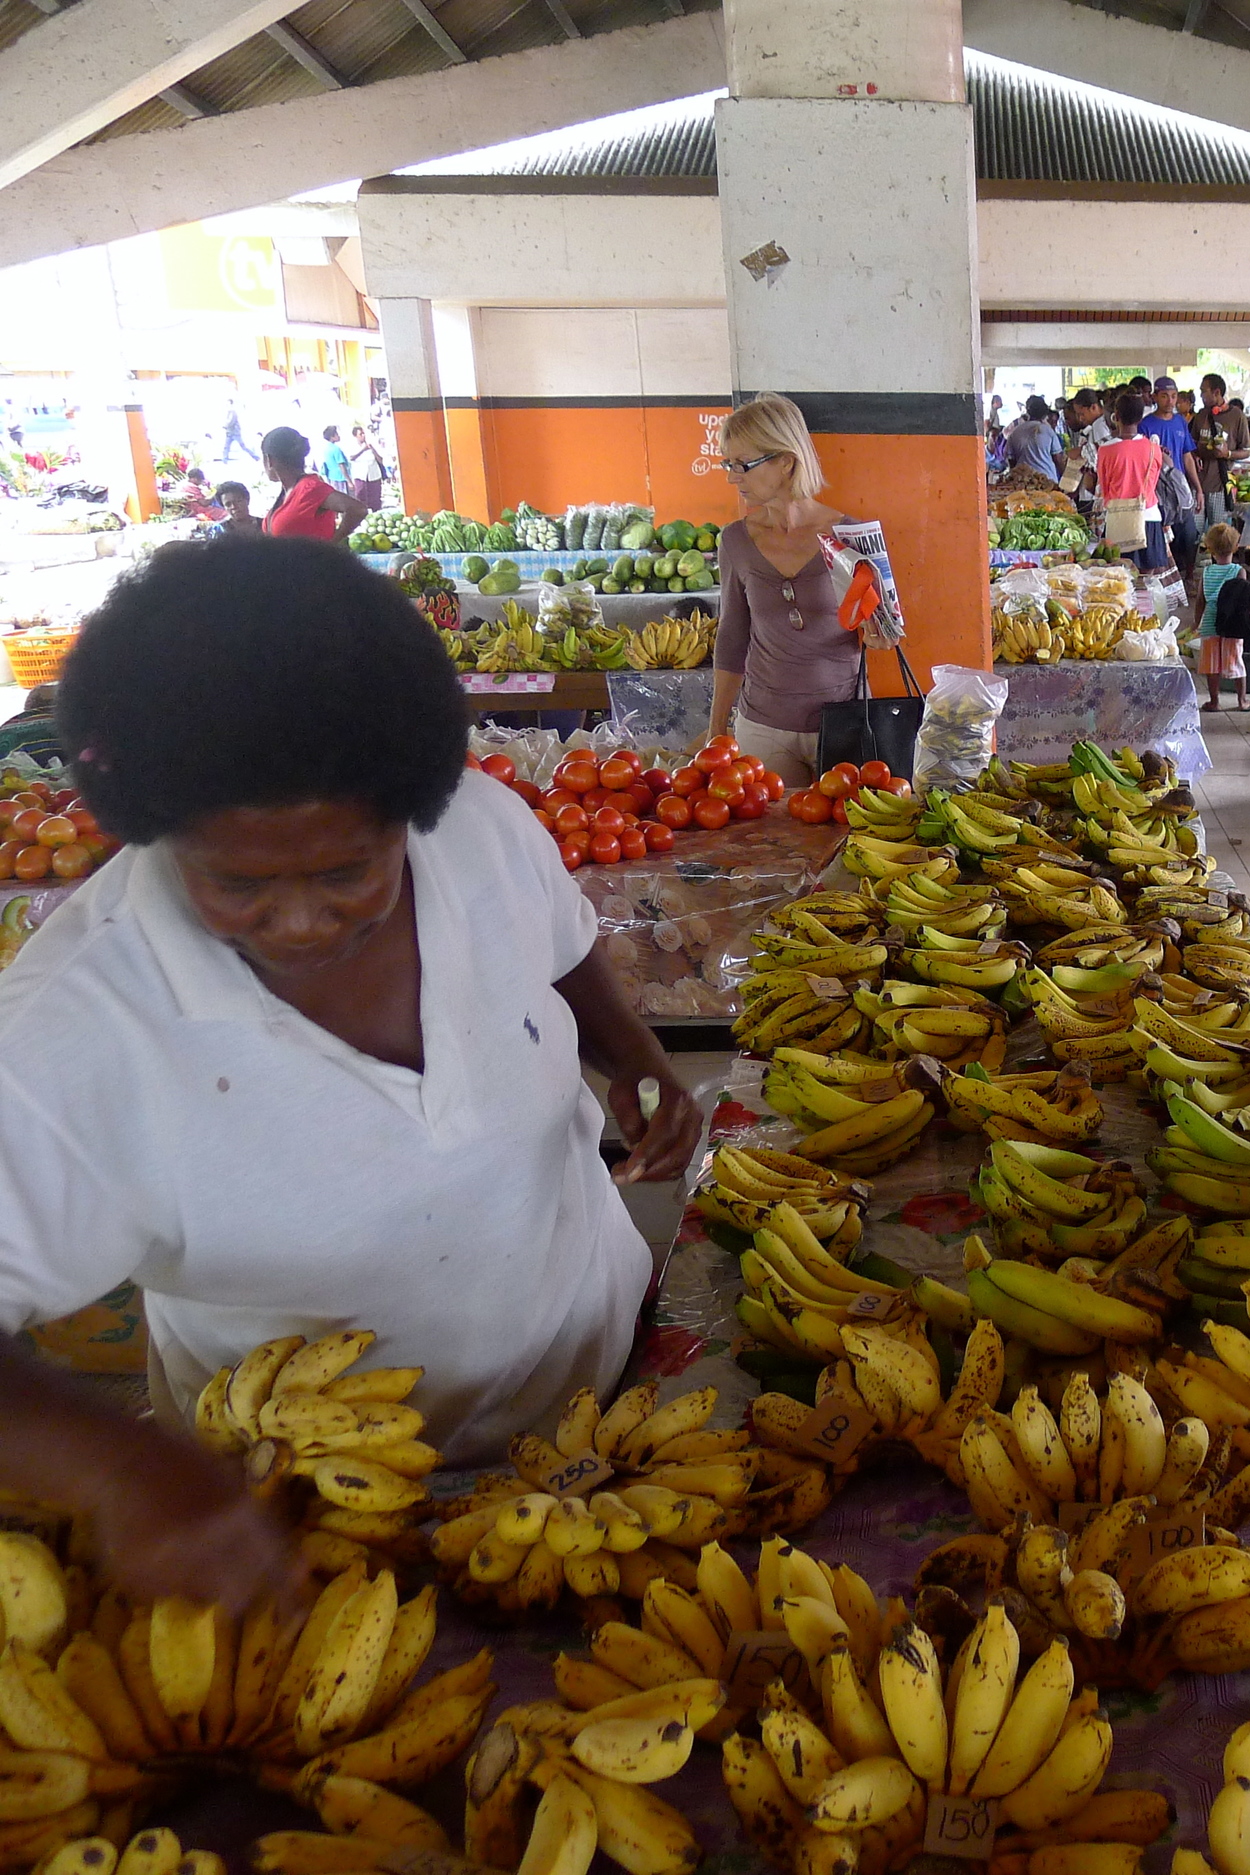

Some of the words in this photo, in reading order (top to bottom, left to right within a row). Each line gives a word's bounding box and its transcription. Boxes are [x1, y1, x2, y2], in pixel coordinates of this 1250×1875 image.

[854, 1295, 882, 1314] 100
[813, 1414, 850, 1451] 100
[548, 1458, 600, 1492] 250
[1148, 1524, 1195, 1556] 100
[728, 1642, 804, 1689] 150
[938, 1805, 990, 1842] 150
